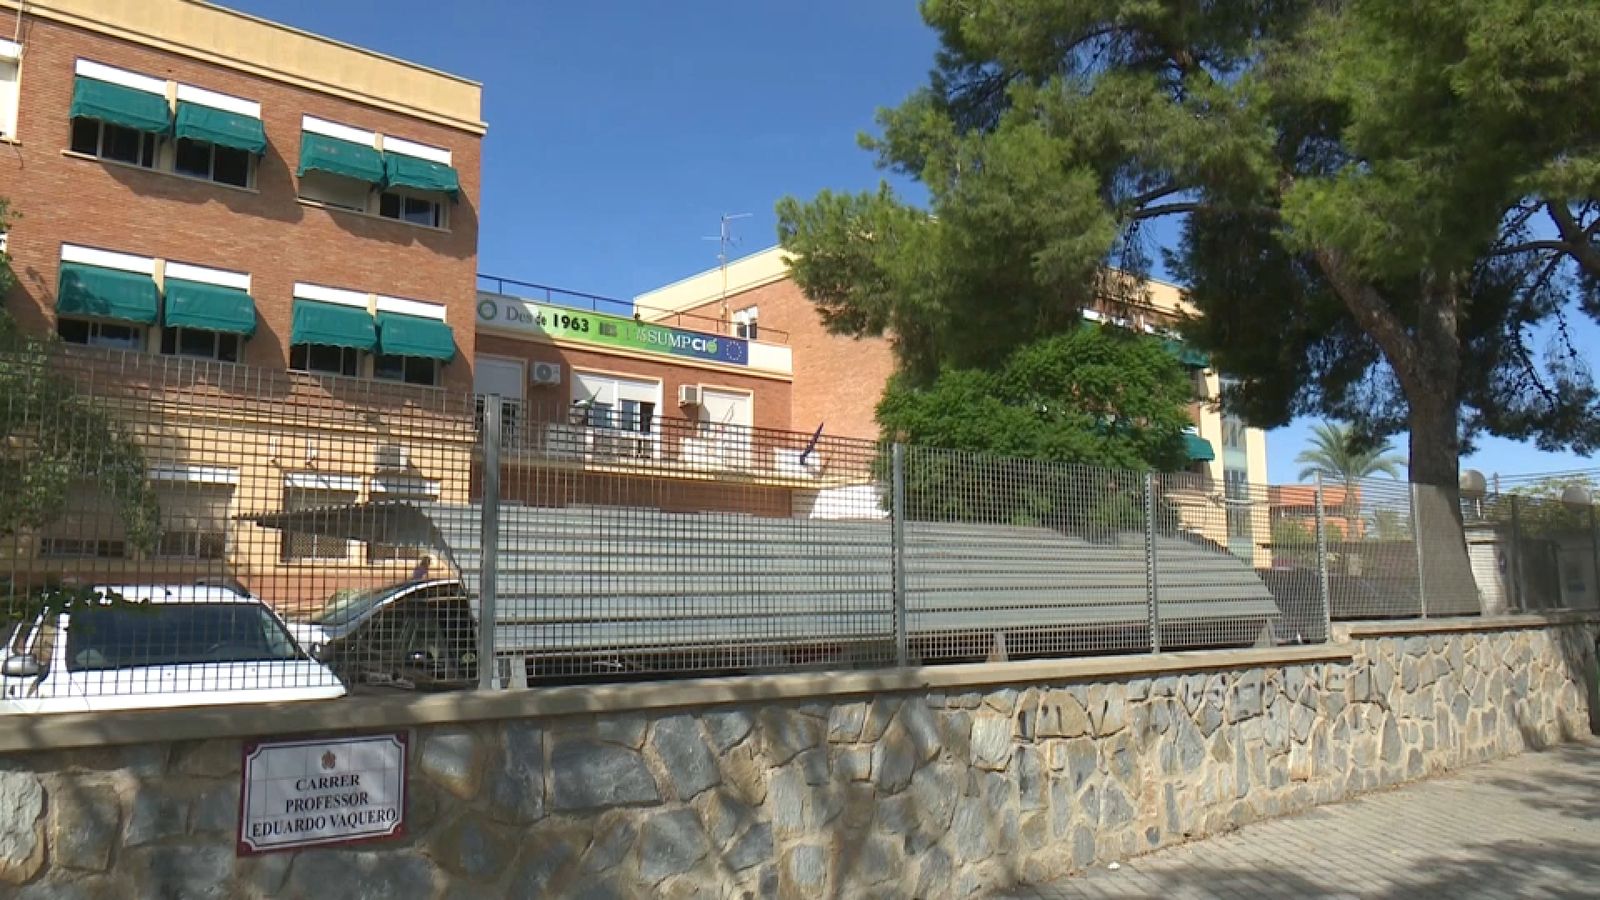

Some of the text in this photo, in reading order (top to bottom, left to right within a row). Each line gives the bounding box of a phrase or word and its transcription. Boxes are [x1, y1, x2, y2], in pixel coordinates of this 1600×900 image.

[553, 313, 589, 332] 1963
[296, 775, 360, 791] CARRER
[286, 792, 368, 813] PROFESSOR
[253, 808, 395, 837] EDUARDO VAQUERO
